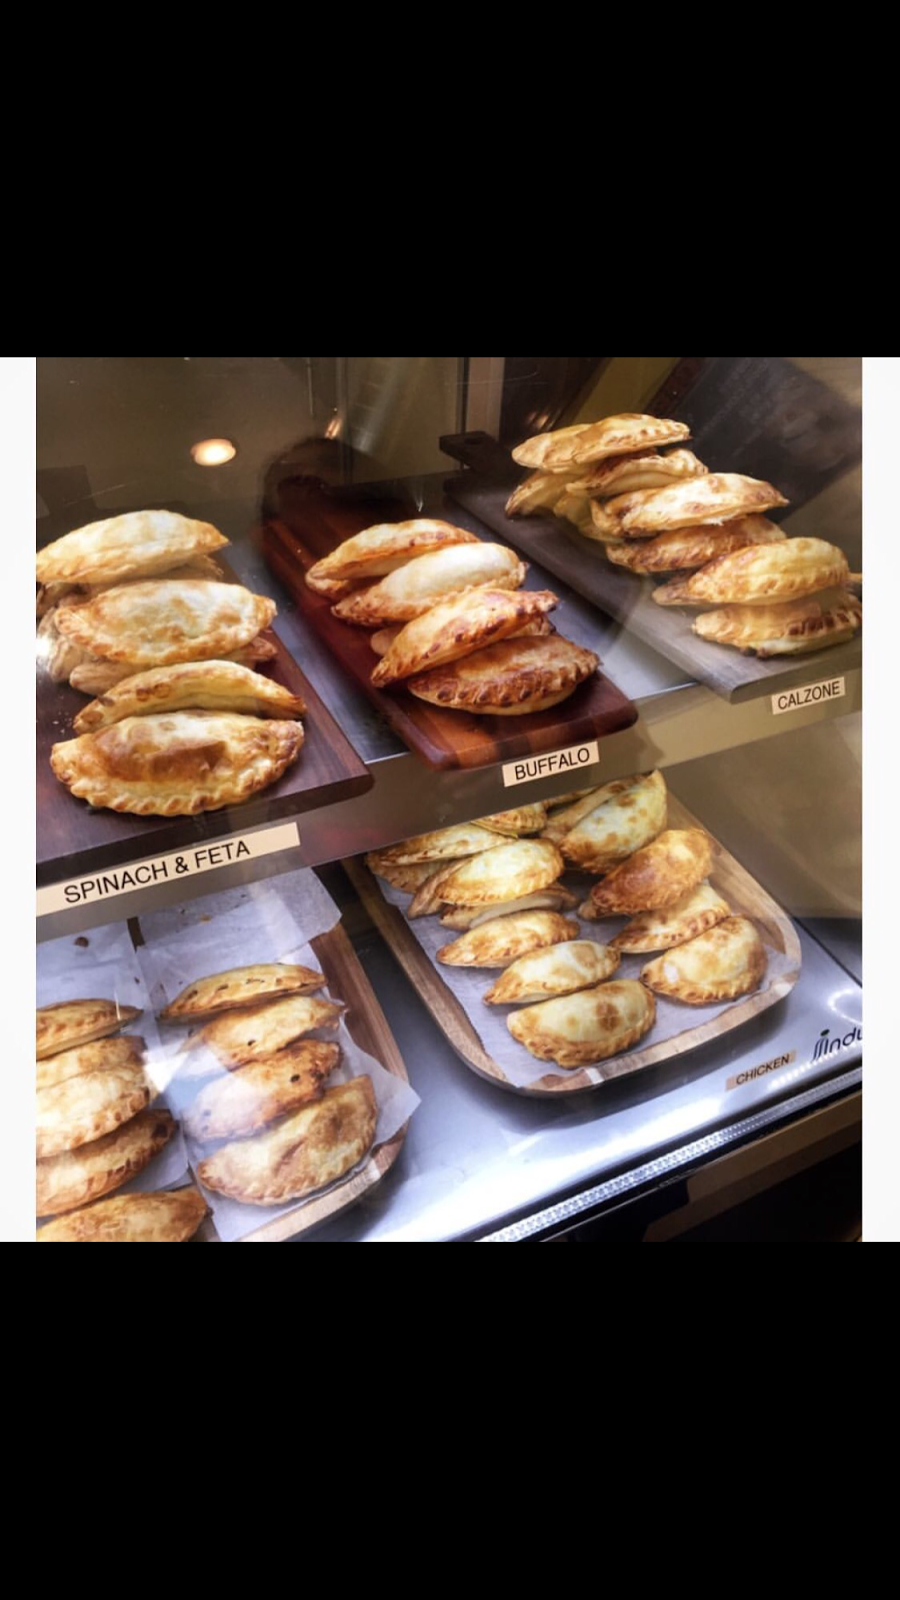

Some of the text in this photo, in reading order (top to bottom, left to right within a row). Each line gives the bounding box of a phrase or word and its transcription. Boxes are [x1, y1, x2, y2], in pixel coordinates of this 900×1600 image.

[778, 681, 840, 710] CALZONE
[515, 748, 590, 780] BUFFALO
[64, 840, 251, 903] SPINACH & FETA
[736, 1053, 791, 1085] CHICKEN
